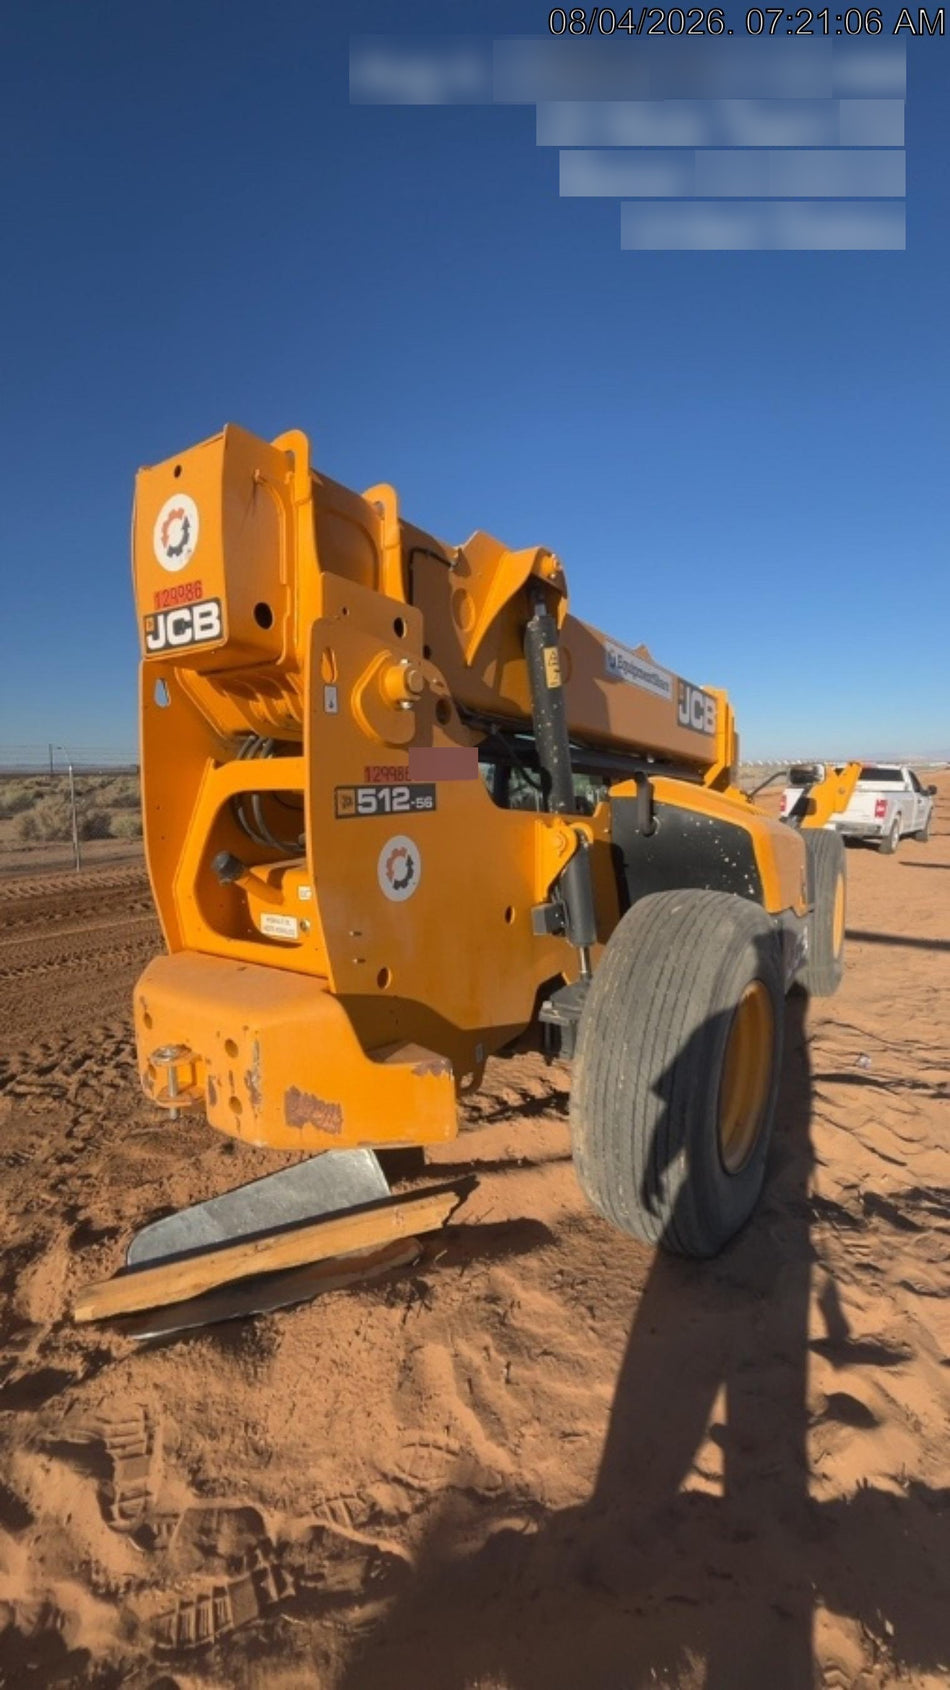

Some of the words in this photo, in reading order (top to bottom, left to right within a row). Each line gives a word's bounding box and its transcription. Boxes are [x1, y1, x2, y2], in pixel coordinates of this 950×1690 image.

[154, 580, 203, 610] 129986
[146, 601, 221, 650] JCB
[679, 685, 716, 735] JCB
